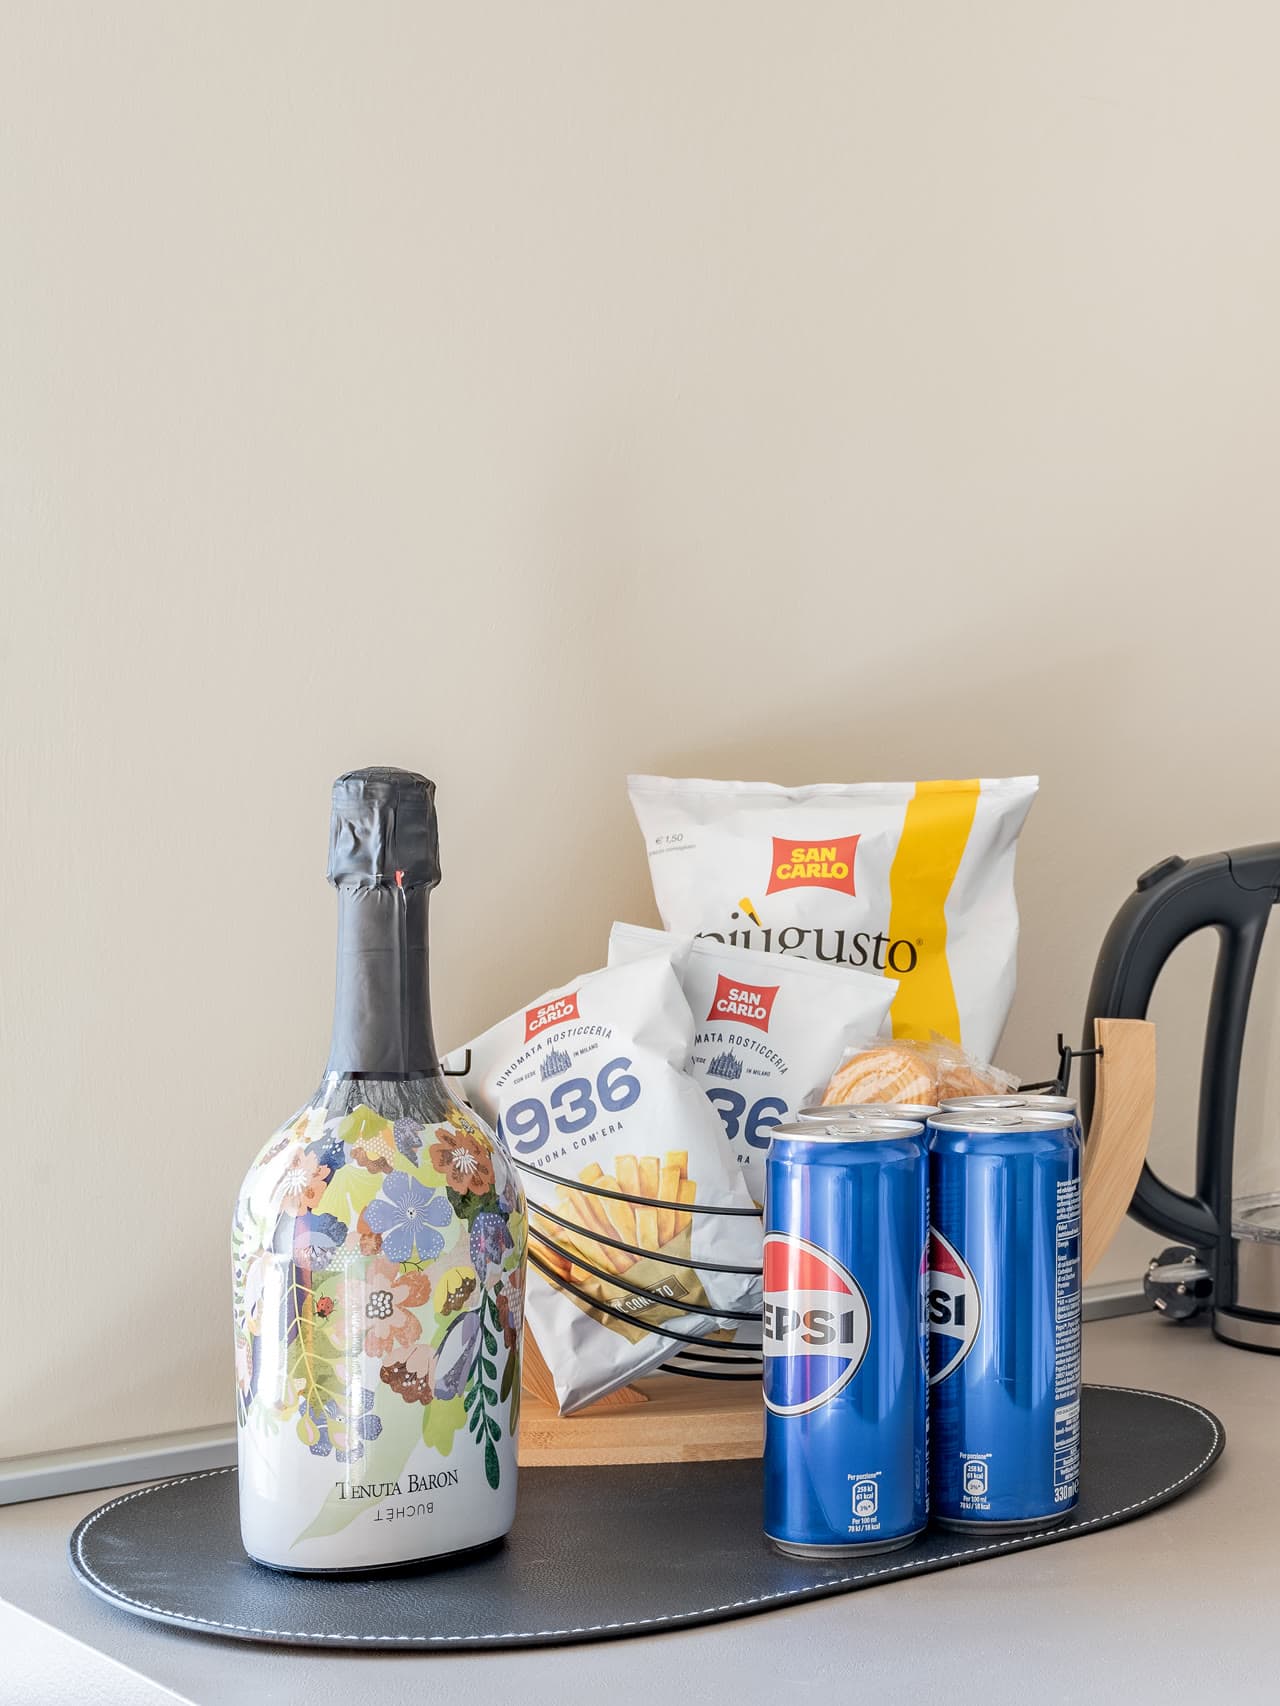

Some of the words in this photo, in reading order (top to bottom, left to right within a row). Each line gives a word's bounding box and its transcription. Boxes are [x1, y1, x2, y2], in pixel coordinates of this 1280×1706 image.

[790, 847, 837, 863] SAN
[776, 862, 849, 880] CARLO
[695, 897, 918, 973] iùgusto
[537, 999, 566, 1018] SAN
[717, 1000, 767, 1019] CARLO
[728, 988, 761, 1005] SAN
[529, 1004, 574, 1031] CARLO
[496, 1044, 542, 1087] RINOMATA
[546, 1025, 612, 1045] ROSTICCERIA
[694, 1033, 723, 1046] MATA
[729, 1034, 789, 1075] ROSTICCERIA
[705, 1087, 788, 1149] 36
[765, 1303, 854, 1345] EPSI
[336, 1481, 402, 1500] TENUTA
[408, 1469, 459, 1493] BARON
